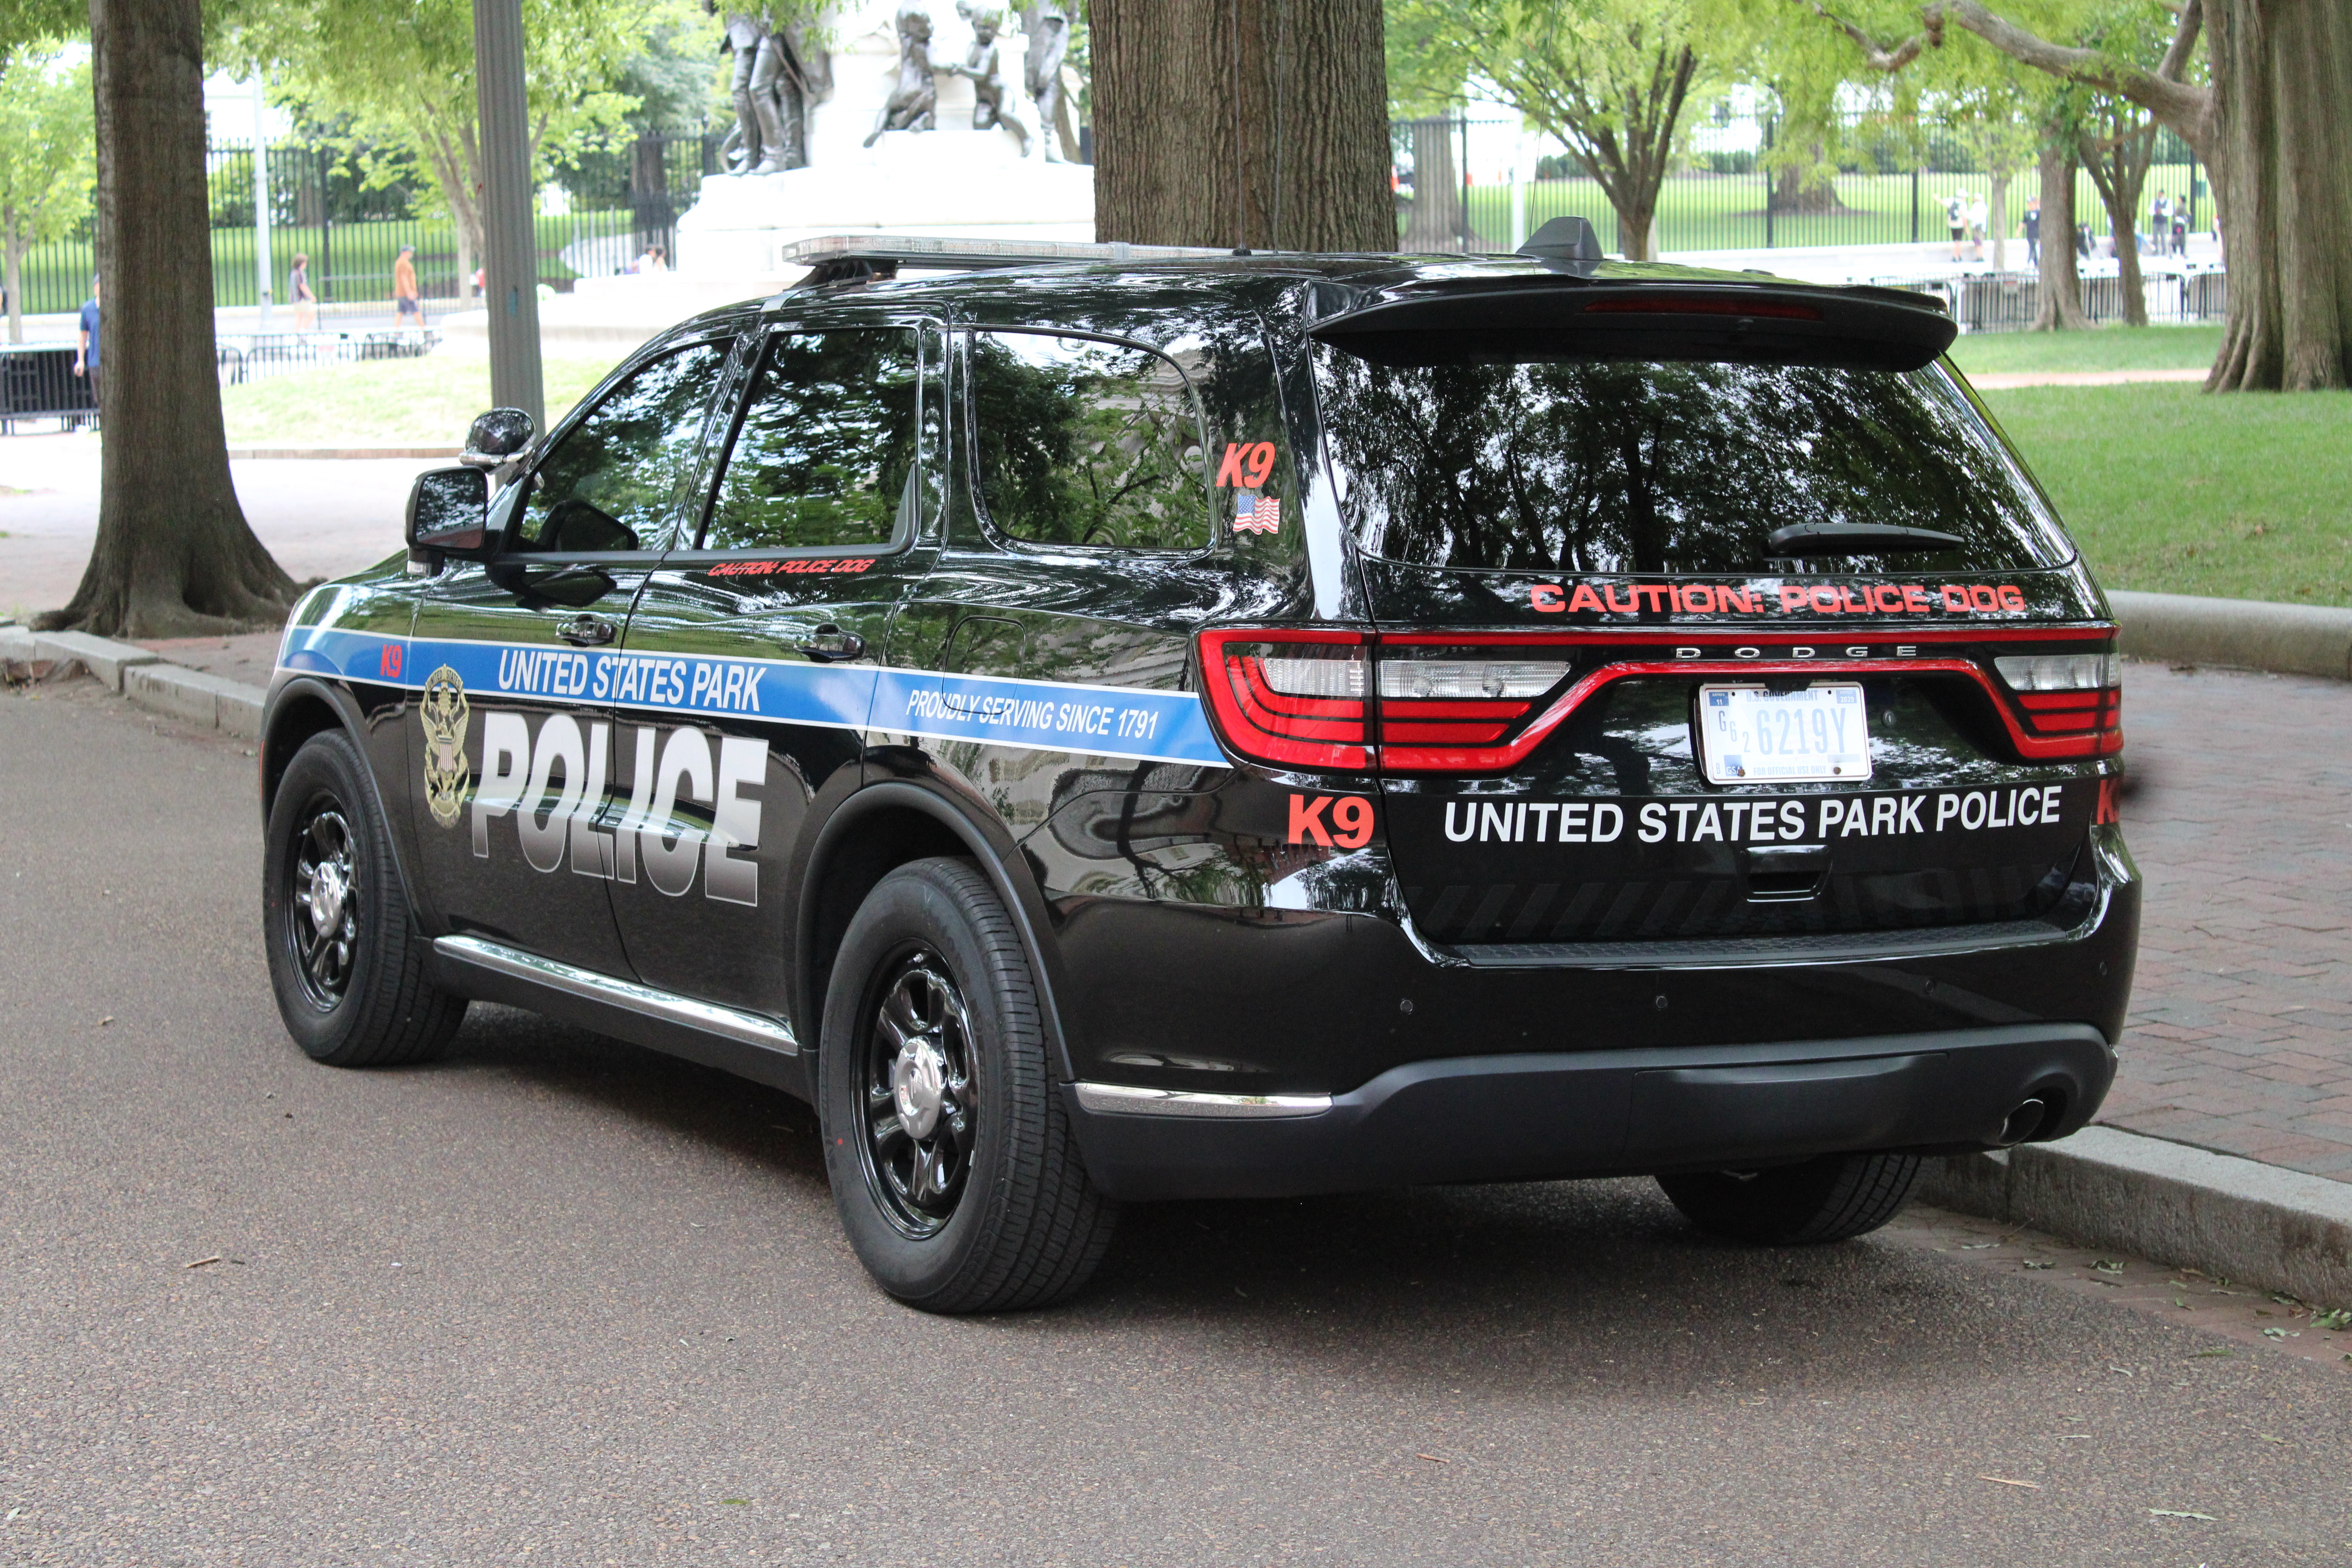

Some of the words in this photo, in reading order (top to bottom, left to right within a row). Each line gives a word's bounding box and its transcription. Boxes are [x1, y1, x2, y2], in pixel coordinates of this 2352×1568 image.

[1216, 442, 1275, 488] K9
[708, 562, 779, 576] CAUTION:
[776, 560, 838, 573] POLICE
[832, 559, 875, 572] DOG
[1530, 584, 1764, 612] CAUTION:
[1780, 586, 1930, 612] POLICE
[1940, 585, 2025, 612] DOG
[381, 645, 401, 678] K9
[1676, 645, 1916, 659] DODGE
[446, 669, 461, 689] STATES
[499, 649, 588, 695] UNITED
[592, 656, 686, 705] STATES
[690, 662, 767, 712] PARK
[1746, 691, 1762, 702] U.S.
[1763, 690, 1818, 702] GOVERNMENT
[906, 690, 981, 722] PROUDLY
[979, 697, 1054, 730] SERVING
[1056, 703, 1114, 735] SINCE
[1117, 708, 1159, 739] 1791
[1756, 708, 1846, 755] 6219Y
[1753, 767, 1766, 776] FOR
[1768, 766, 1796, 775] OFFICIAL
[1797, 766, 1811, 775] USE
[1811, 765, 1826, 774] ONLY
[471, 712, 769, 907] POLICE
[1288, 794, 1374, 848] K9
[1445, 802, 1623, 842] UNITED
[1638, 800, 1804, 842] STATES
[1818, 794, 1926, 838] PARK
[1936, 786, 2062, 831] POLICE
[2097, 780, 2120, 824] K
